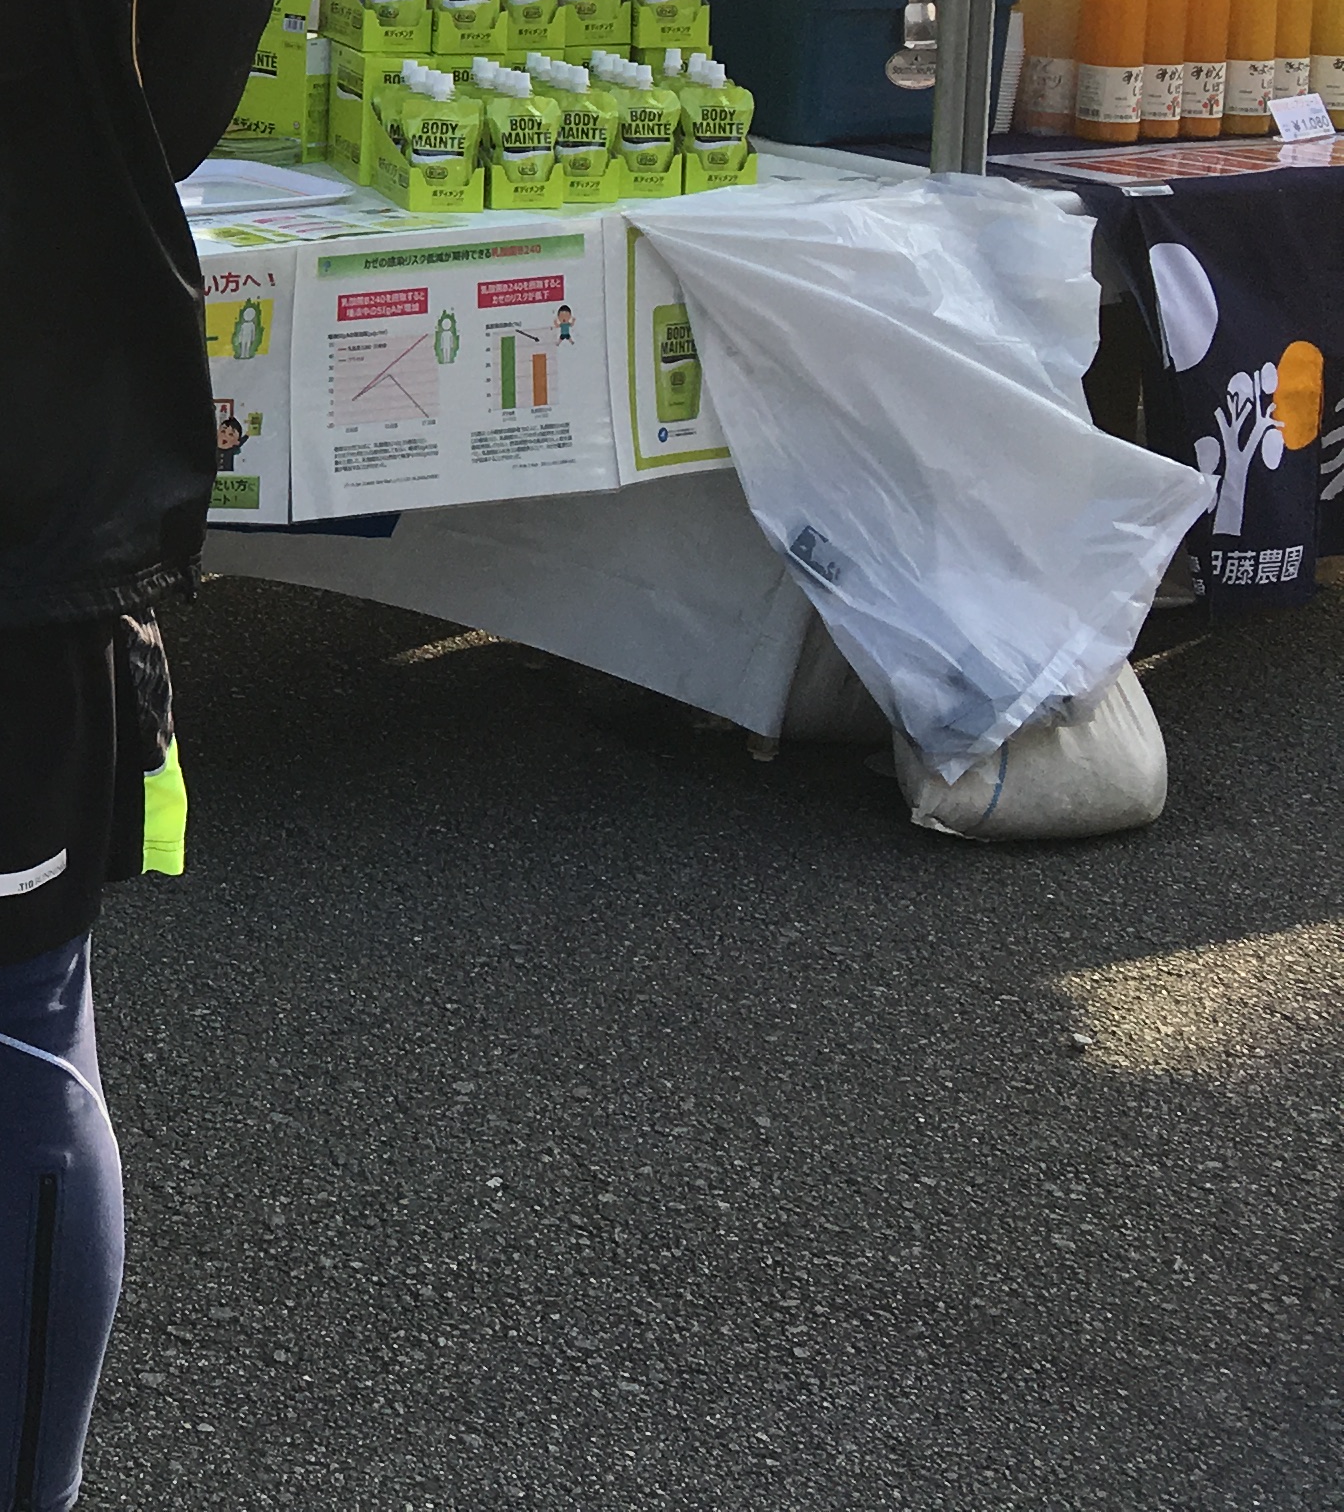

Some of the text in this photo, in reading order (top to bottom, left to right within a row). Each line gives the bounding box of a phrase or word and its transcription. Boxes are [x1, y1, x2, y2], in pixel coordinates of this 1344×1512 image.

[564, 113, 599, 127] BODY
[629, 109, 664, 122] BODY
[701, 108, 736, 122] BODY
[421, 122, 459, 136] BODY
[509, 117, 543, 131] BODY
